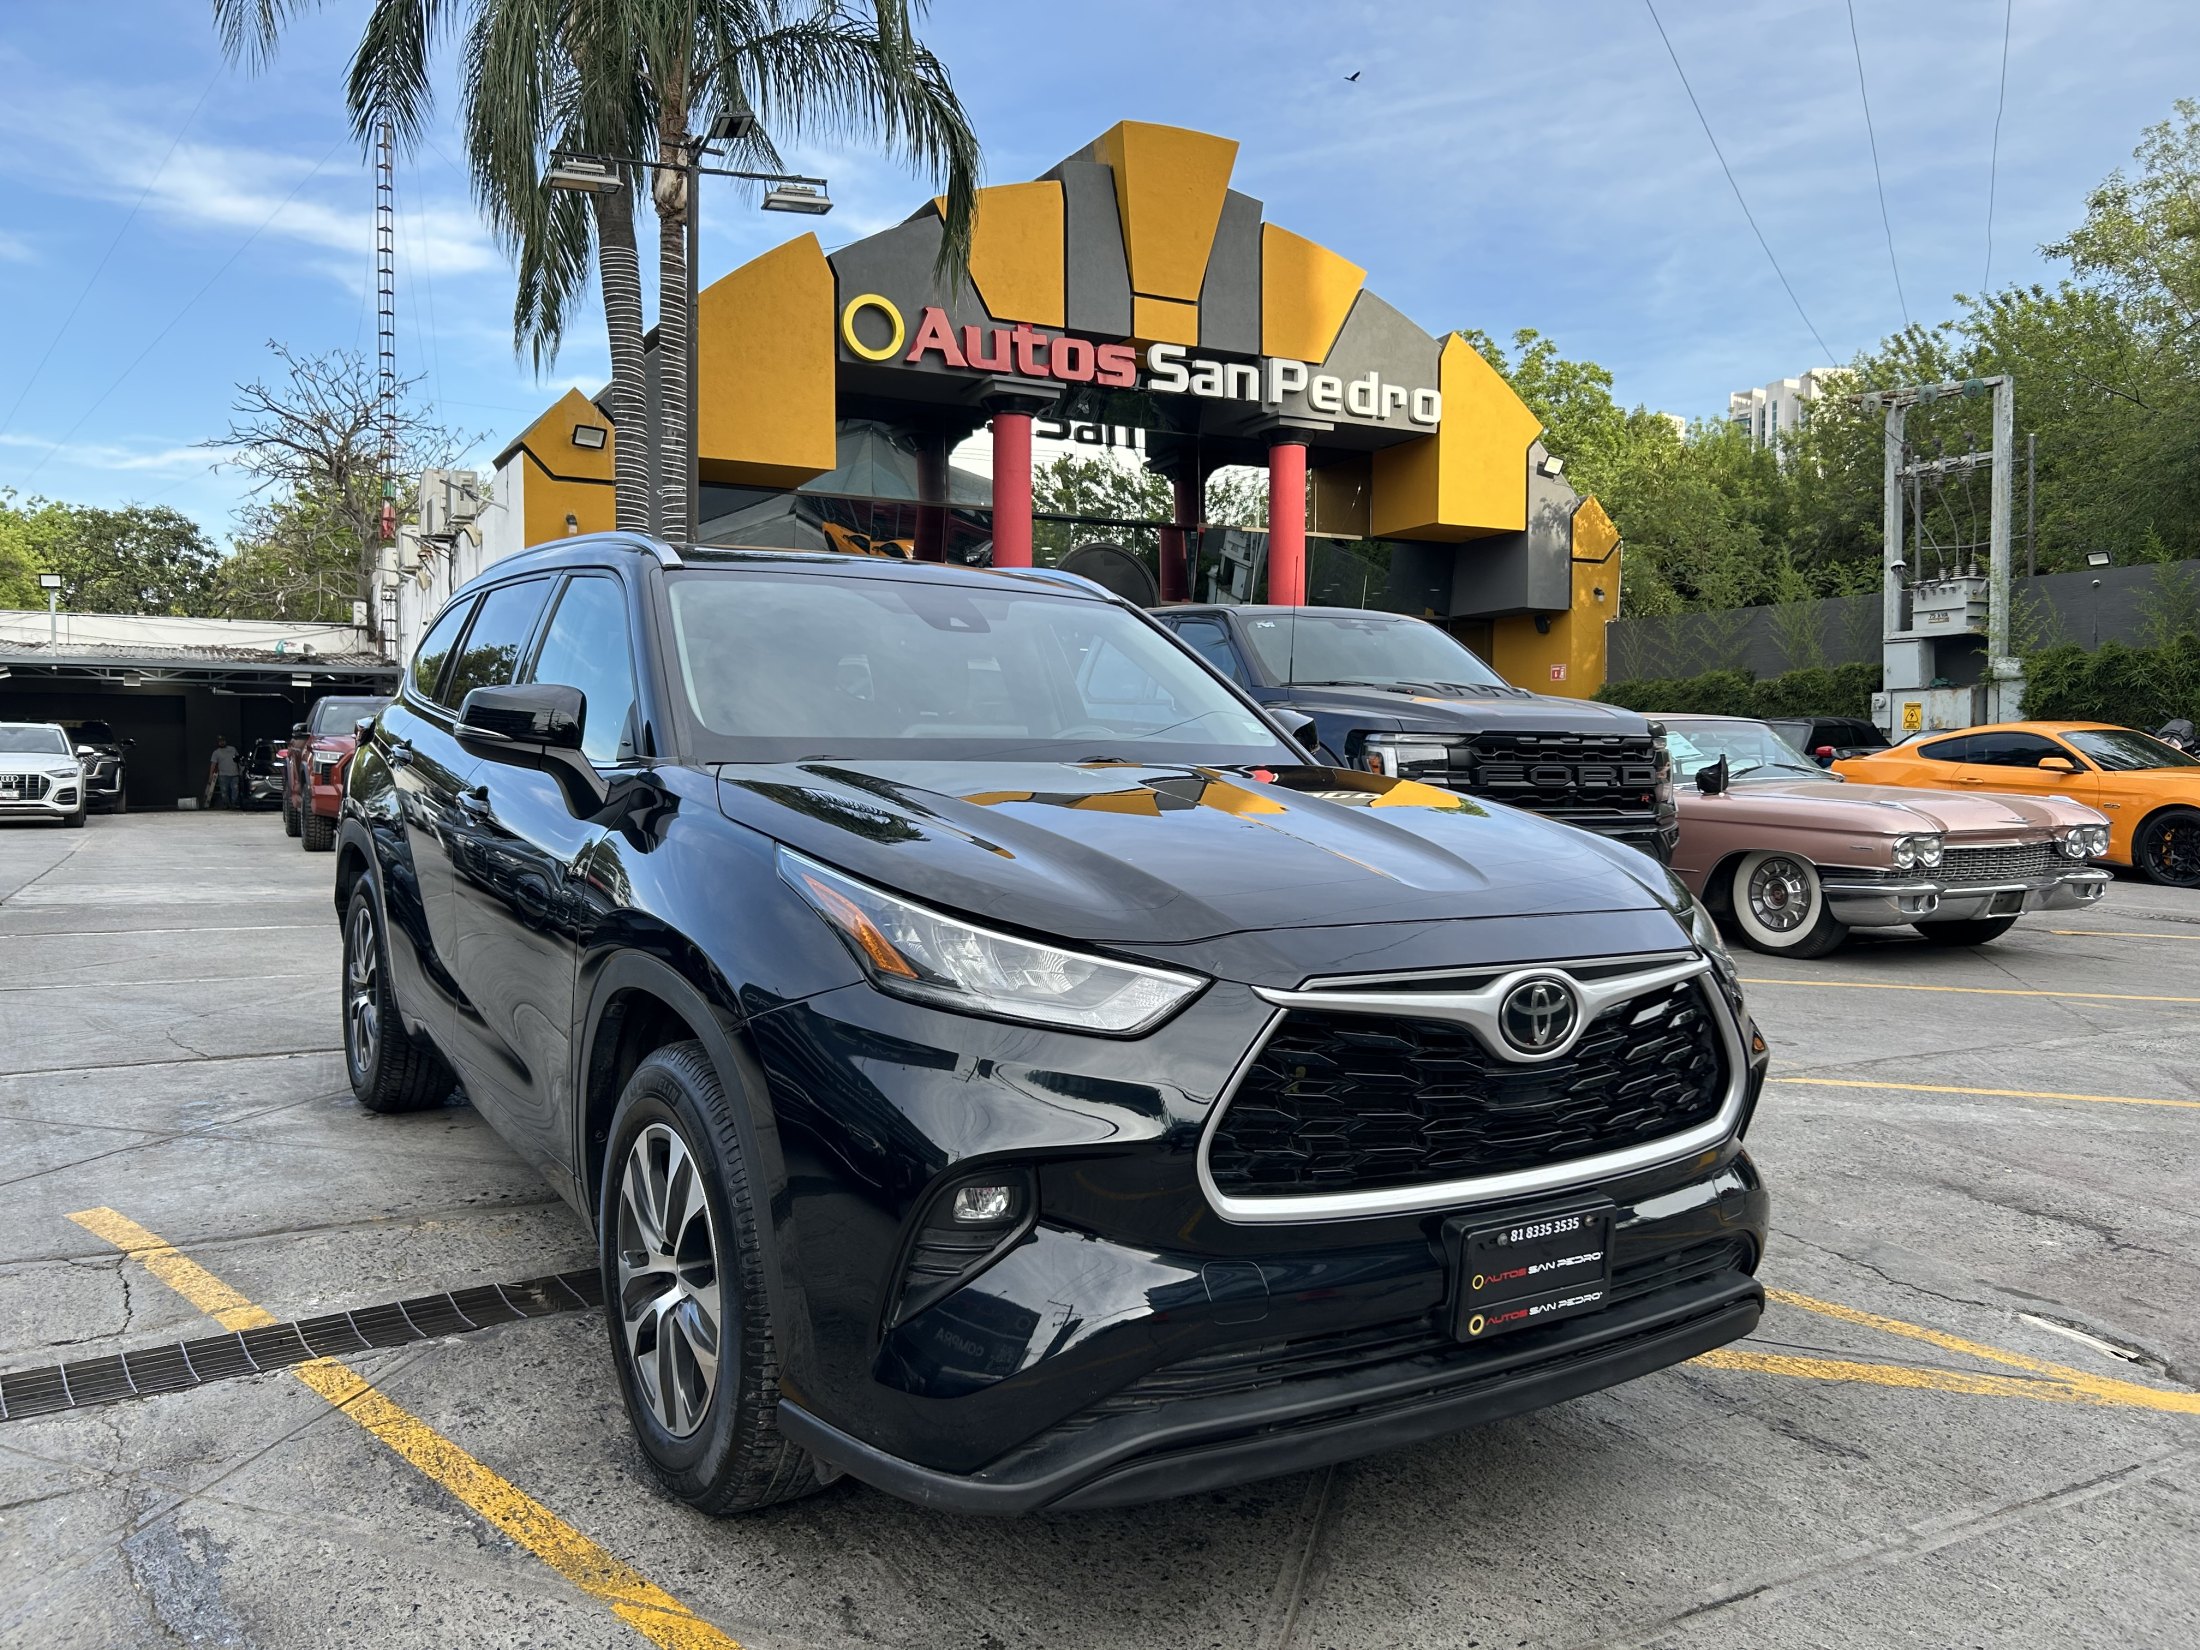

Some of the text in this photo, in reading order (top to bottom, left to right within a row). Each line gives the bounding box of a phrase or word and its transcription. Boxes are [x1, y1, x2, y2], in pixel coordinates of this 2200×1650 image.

[906, 307, 1442, 424] Autos San Pedro
[1479, 765, 1656, 787] FORD
[1641, 795, 1650, 803] R
[628, 1071, 679, 1102] ELIN
[1510, 1217, 1580, 1242] 81 8335 3535
[1484, 1251, 1602, 1285] AUTOS SAN PEDRO
[1485, 1293, 1601, 1326] AUTOS SAN PEDRO
